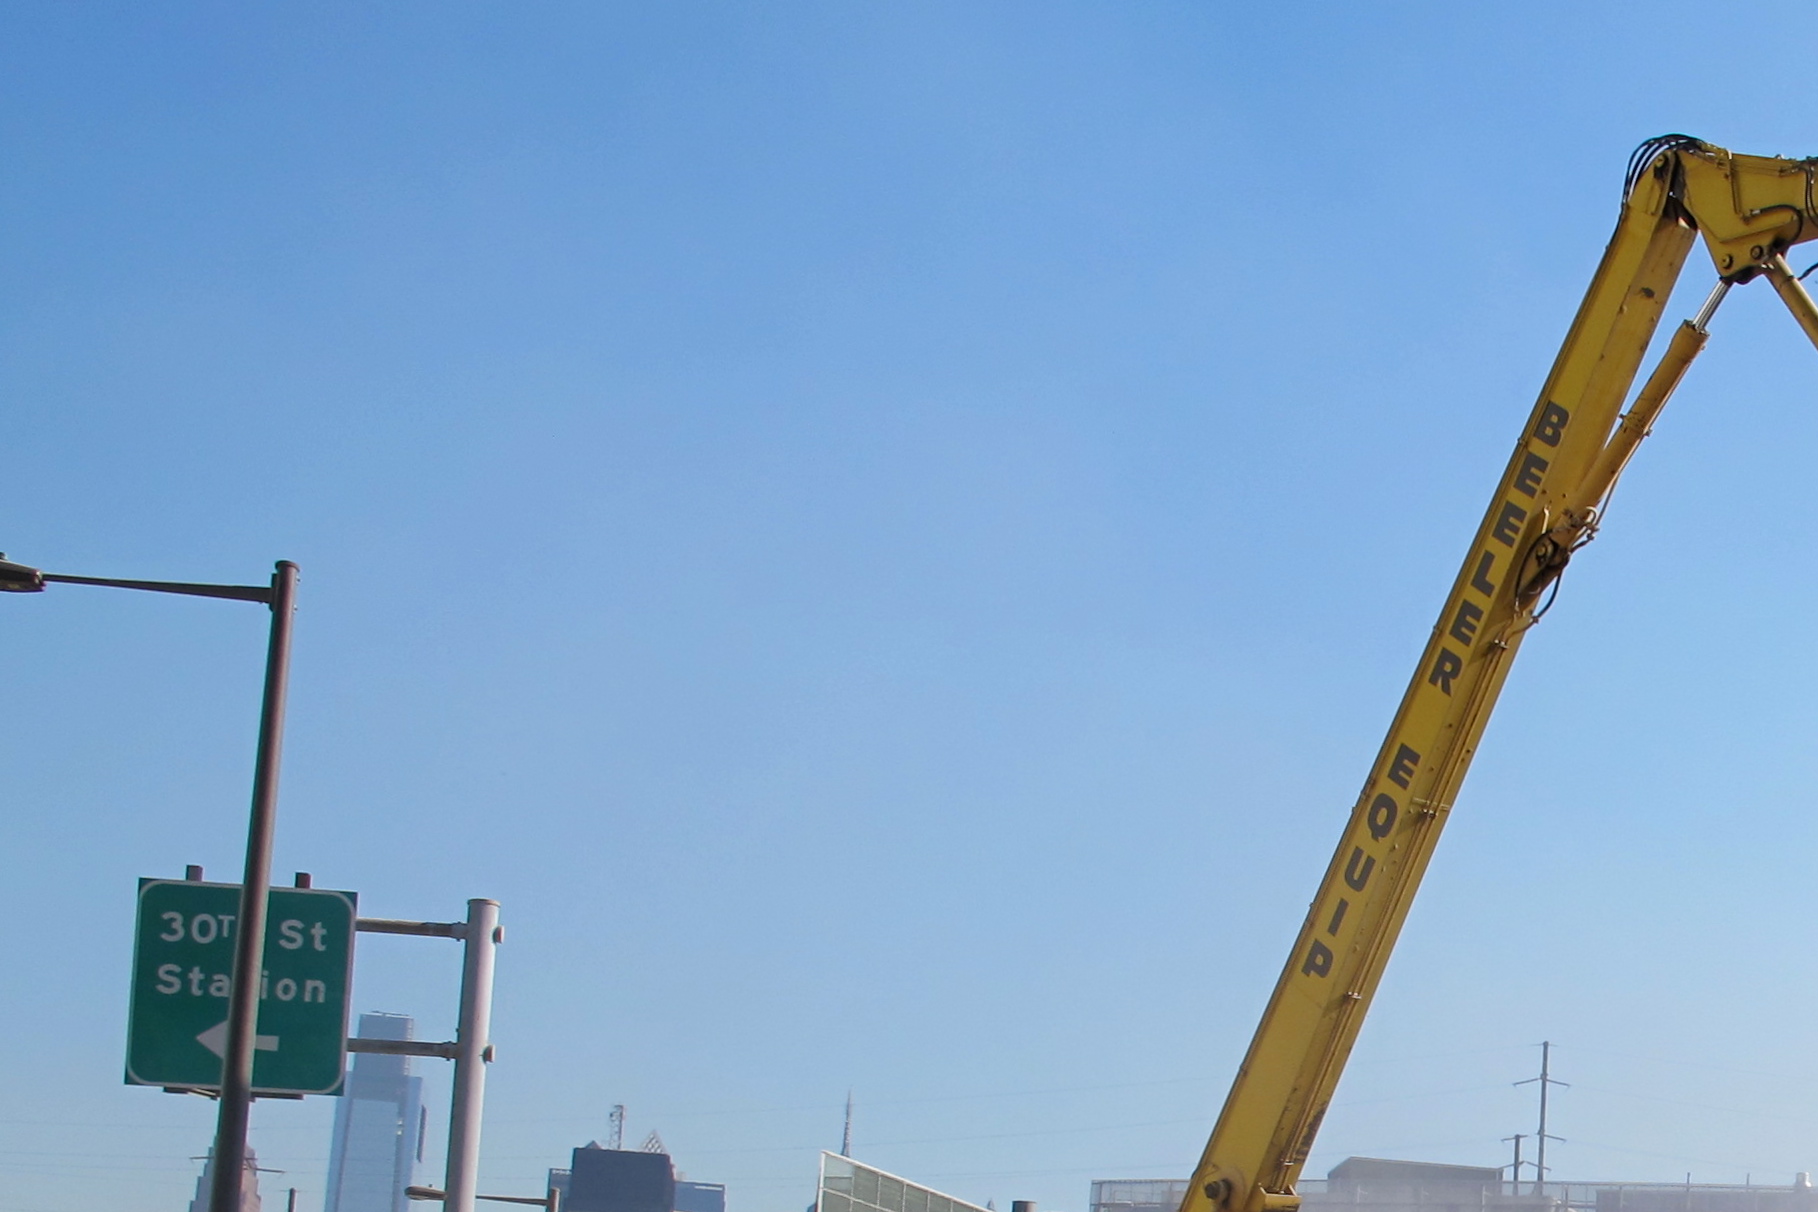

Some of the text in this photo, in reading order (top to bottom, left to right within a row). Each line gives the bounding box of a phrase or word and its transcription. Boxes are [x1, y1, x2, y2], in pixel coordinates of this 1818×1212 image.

[1301, 400, 1570, 979] BEELER EQUIP
[160, 911, 328, 951] 30T St
[155, 963, 327, 1003] Staion
